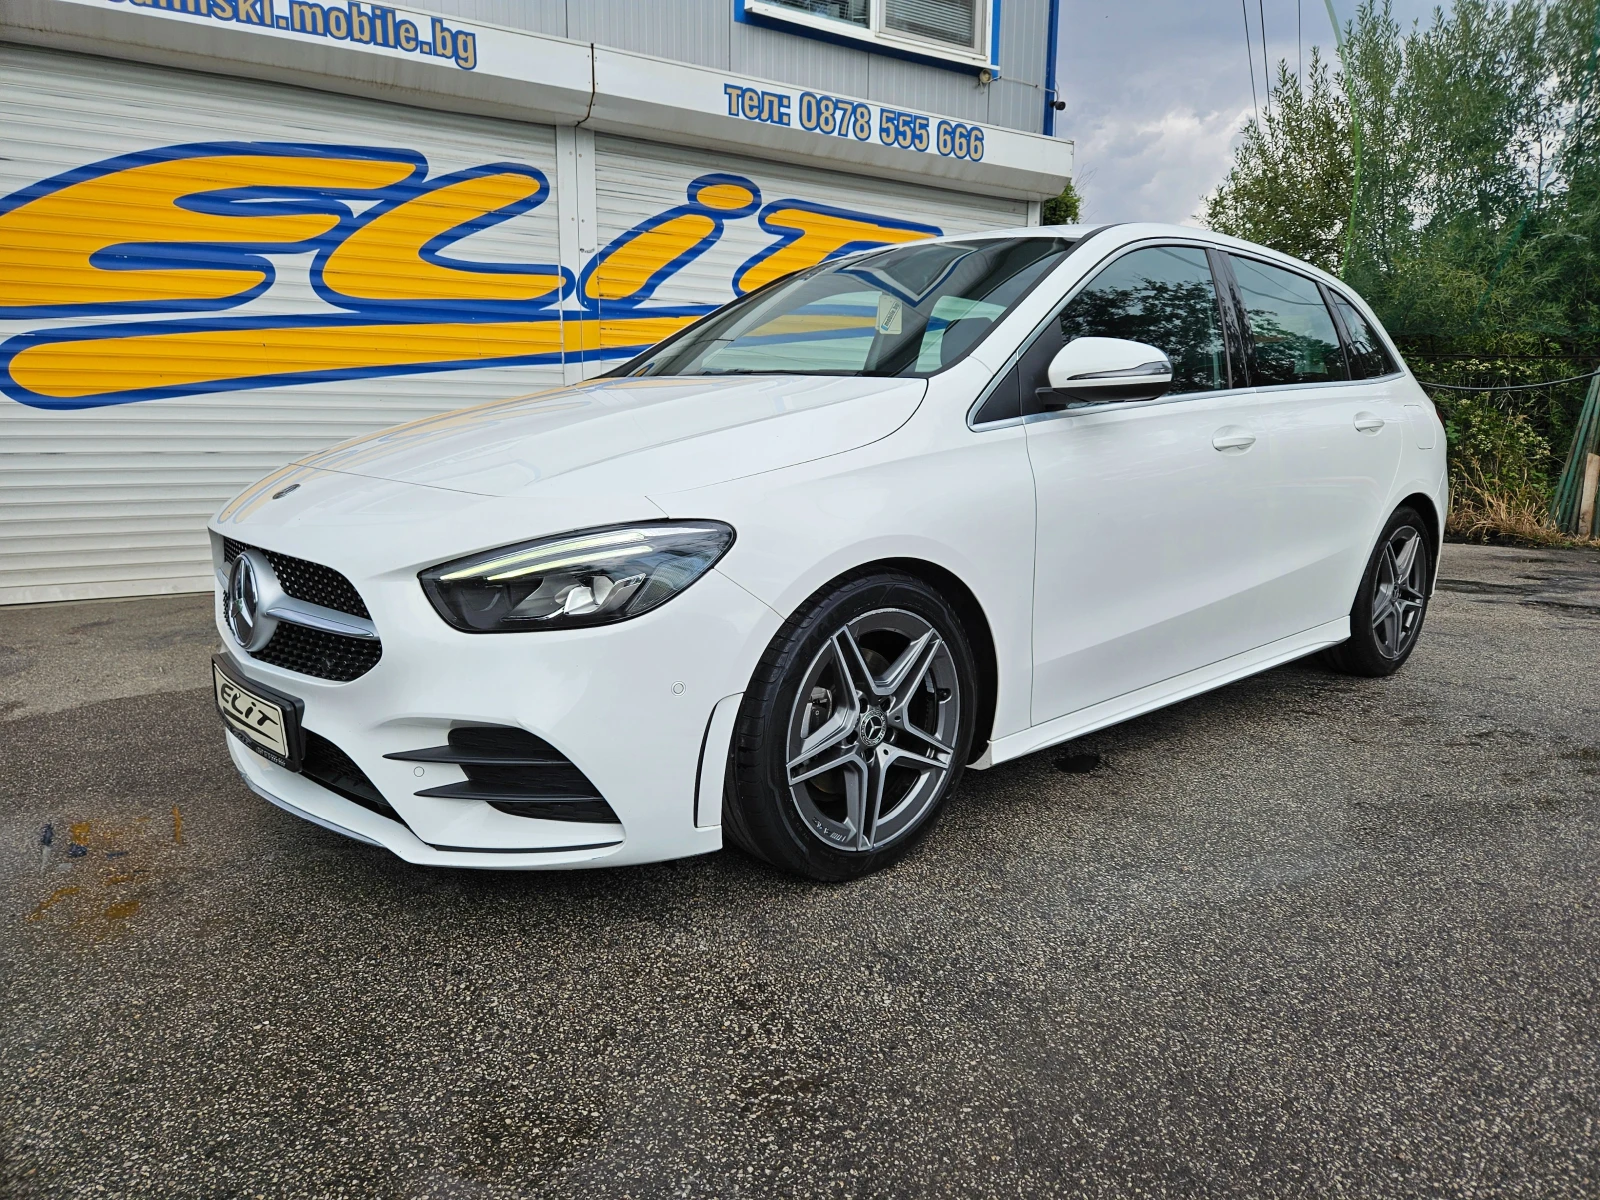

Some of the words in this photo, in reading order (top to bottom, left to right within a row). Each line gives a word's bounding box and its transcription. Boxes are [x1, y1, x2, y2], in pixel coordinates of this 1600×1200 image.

[724, 83, 791, 127] тел:
[800, 91, 872, 141] 0878
[879, 108, 930, 152] 555
[936, 120, 985, 162] 666
